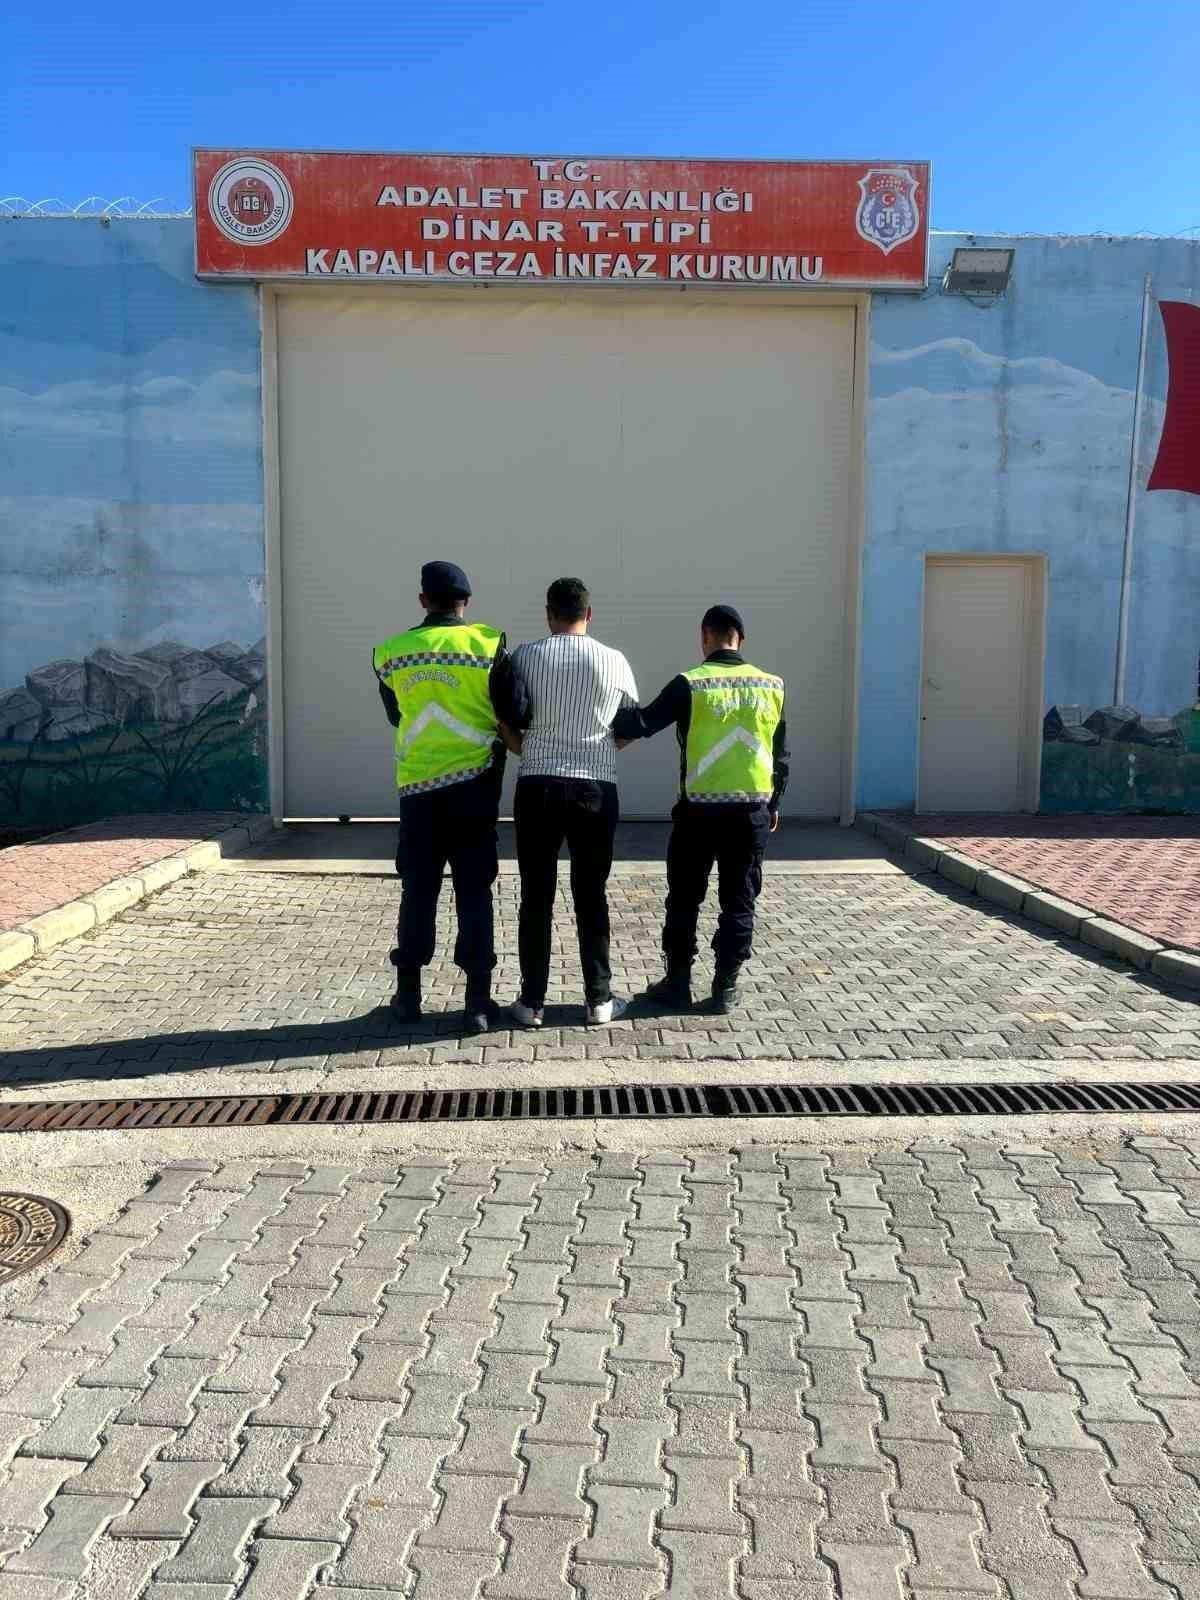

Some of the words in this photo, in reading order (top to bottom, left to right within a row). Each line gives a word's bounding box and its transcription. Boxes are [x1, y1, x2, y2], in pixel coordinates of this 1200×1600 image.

[531, 160, 601, 183] T.C.
[376, 185, 528, 209] ADALET
[541, 187, 753, 212] BAKANLIĞI
[219, 205, 245, 232] ADALET
[421, 214, 566, 242] DİNAR
[579, 217, 711, 244] T-TİPİ
[304, 248, 435, 275] KAPALI
[448, 251, 543, 276] CEZA
[554, 247, 657, 279] İNFAZ
[669, 254, 823, 281] KURUMU
